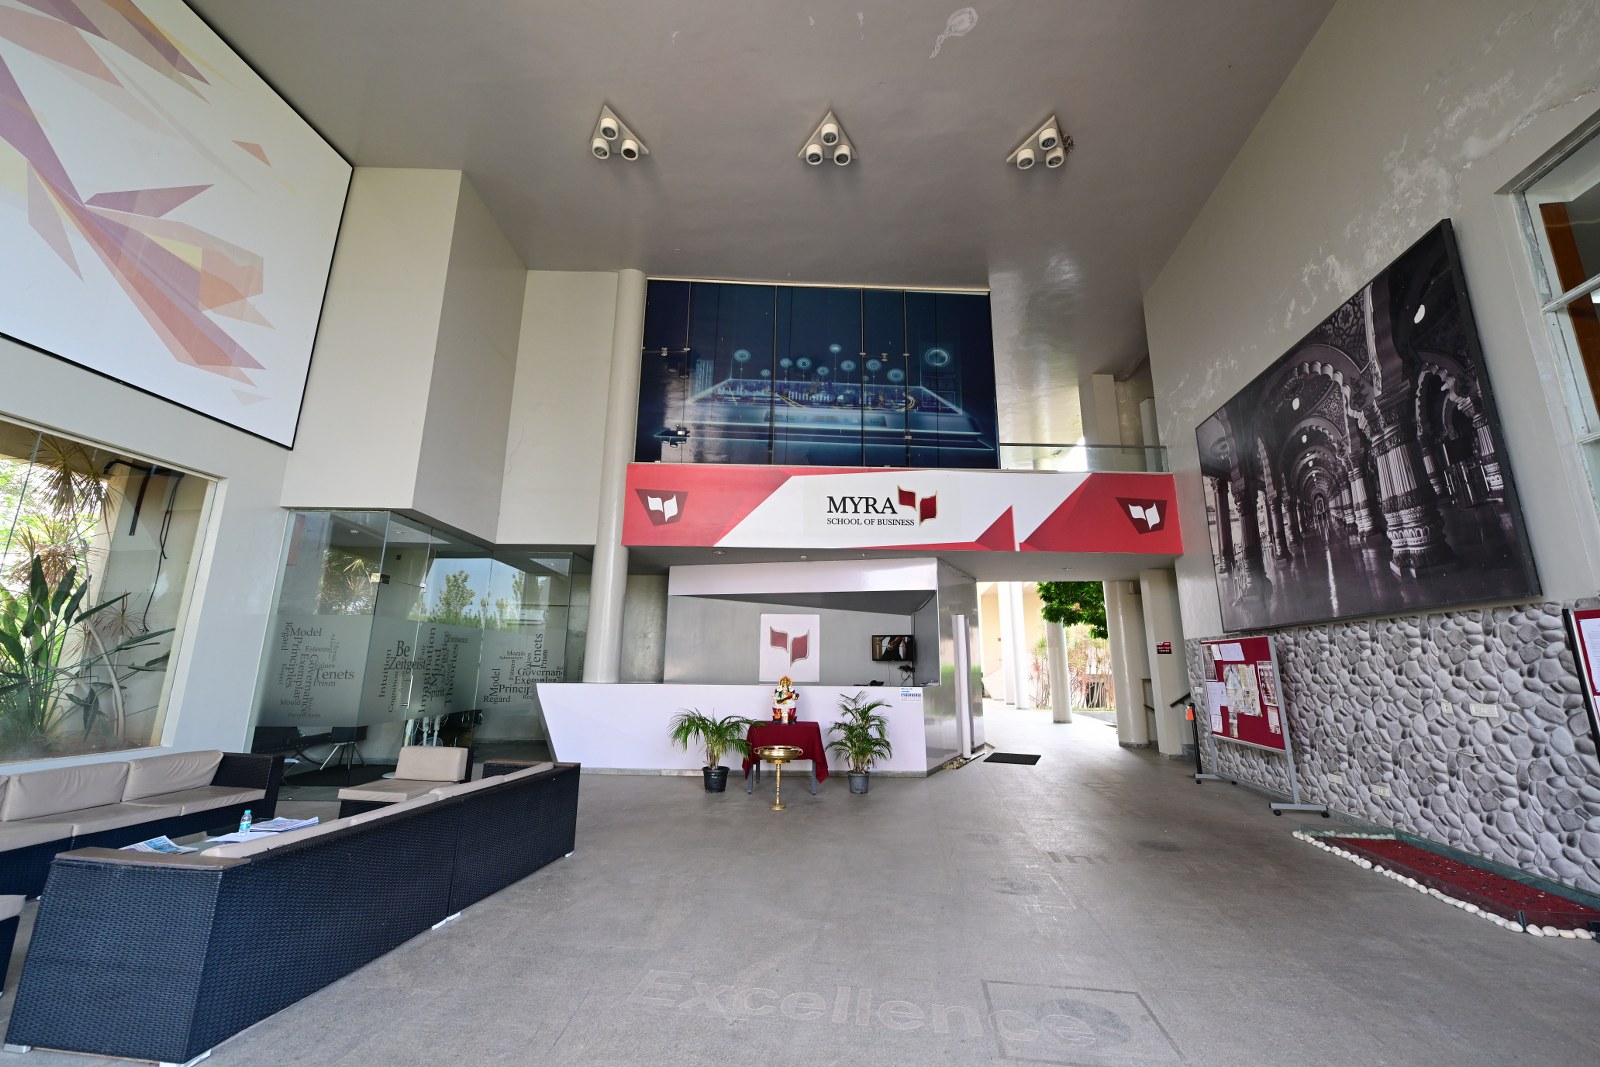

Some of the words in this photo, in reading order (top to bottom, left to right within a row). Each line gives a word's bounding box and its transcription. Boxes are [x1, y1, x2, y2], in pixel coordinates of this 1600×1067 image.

[826, 495, 898, 515] MYRA
[826, 517, 862, 526] SCHOOL
[863, 518, 876, 526] OF
[878, 518, 915, 527] BUSINESS
[281, 622, 293, 651] Regard
[289, 627, 322, 637] Model
[285, 637, 304, 688] Principles
[396, 640, 410, 657] Be
[530, 633, 543, 668] Tenets
[293, 653, 310, 700] Exemplar
[314, 667, 355, 680] Tenets
[379, 649, 392, 697] Intuition
[419, 627, 436, 713] Imagination
[430, 649, 442, 686] Mind
[489, 668, 501, 697] Model
[300, 654, 319, 715] Governance
[483, 695, 511, 705] Regard
[627, 968, 1097, 1047] Excellence
